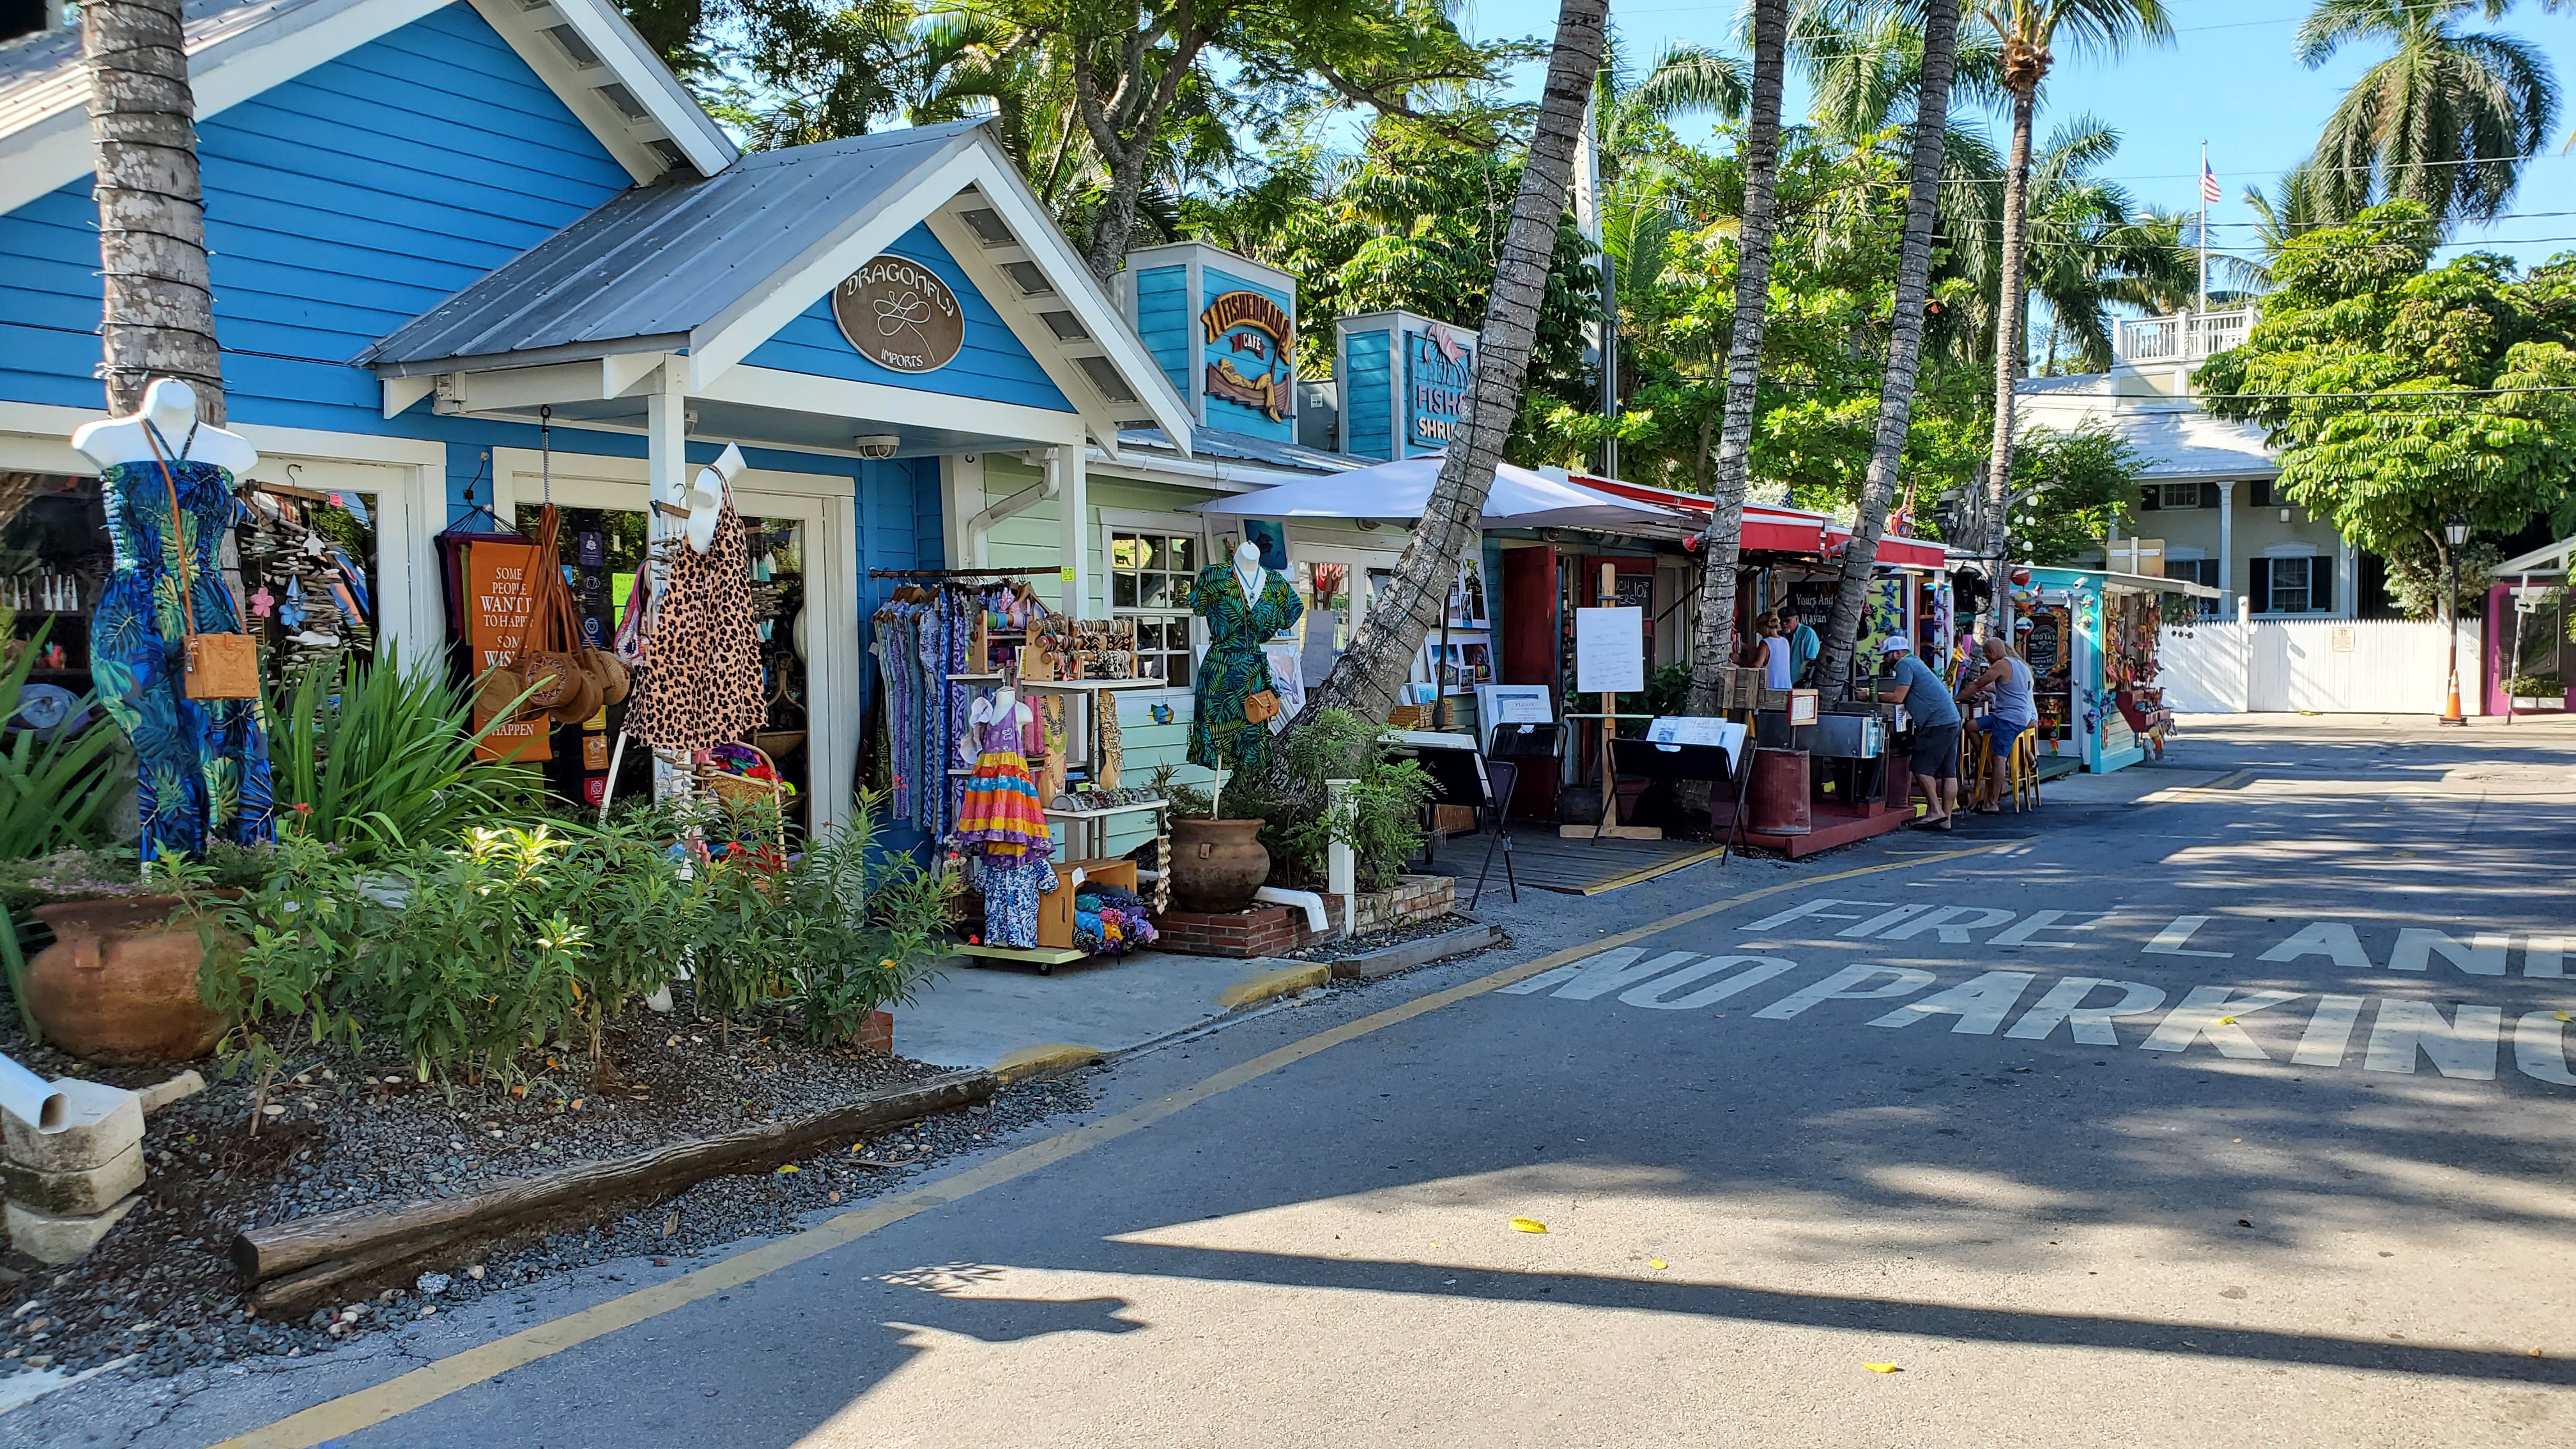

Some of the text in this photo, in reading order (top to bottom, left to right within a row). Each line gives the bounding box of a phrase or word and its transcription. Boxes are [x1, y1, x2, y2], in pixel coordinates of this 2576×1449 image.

[846, 263, 954, 318] DRAGONFLY
[1243, 333, 1261, 351] CAFE
[881, 348, 923, 367] IMPORTS
[1418, 385, 1456, 415] FISH
[496, 567, 523, 580] SOME
[492, 582, 527, 595] PEOPLE
[480, 595, 523, 613] WANT
[1796, 594, 1834, 606] Yours And
[484, 615, 534, 628] TO HAPP
[1801, 613, 1827, 625] Mayan
[497, 636, 528, 648] SOM
[484, 650, 519, 667] WIS
[491, 724, 535, 736] HAPPEN
[1738, 898, 2576, 979] FIRE LANE
[1492, 946, 1798, 1009] NO
